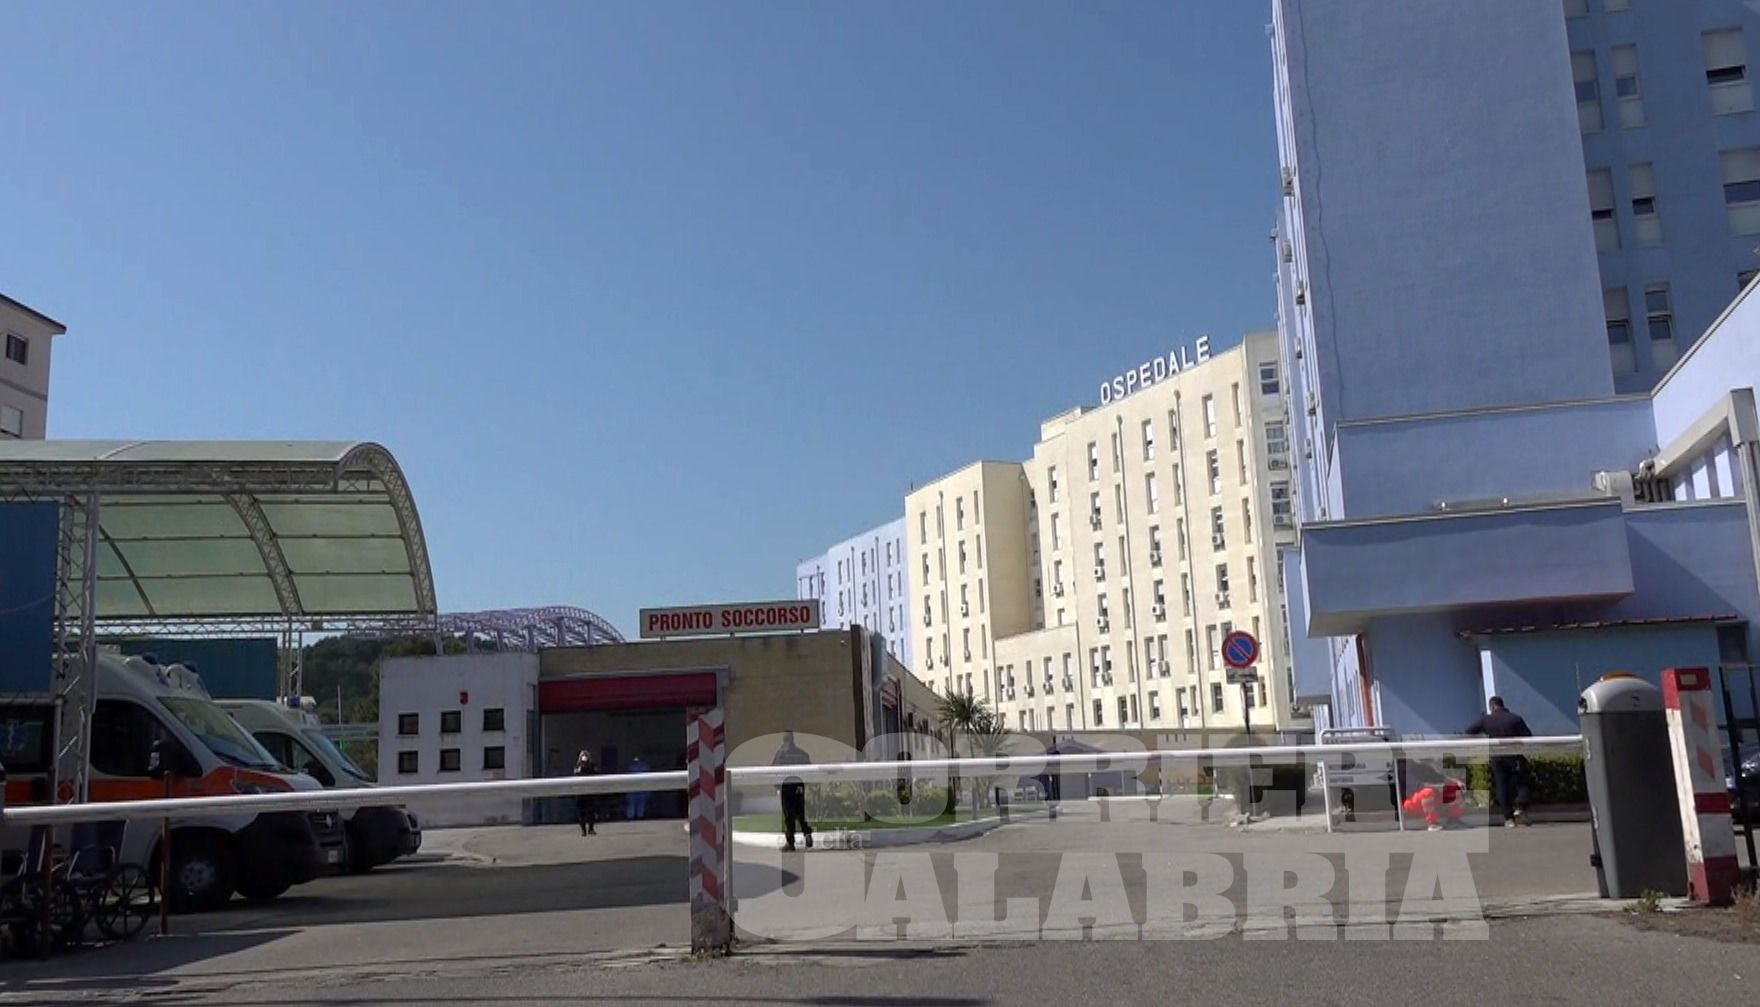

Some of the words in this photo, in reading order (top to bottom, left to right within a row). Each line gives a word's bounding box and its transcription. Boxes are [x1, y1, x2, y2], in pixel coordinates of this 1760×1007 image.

[1100, 335, 1212, 405] OSPEDALE
[649, 611, 713, 631] PRONTO
[721, 605, 811, 628] SOCCORSO
